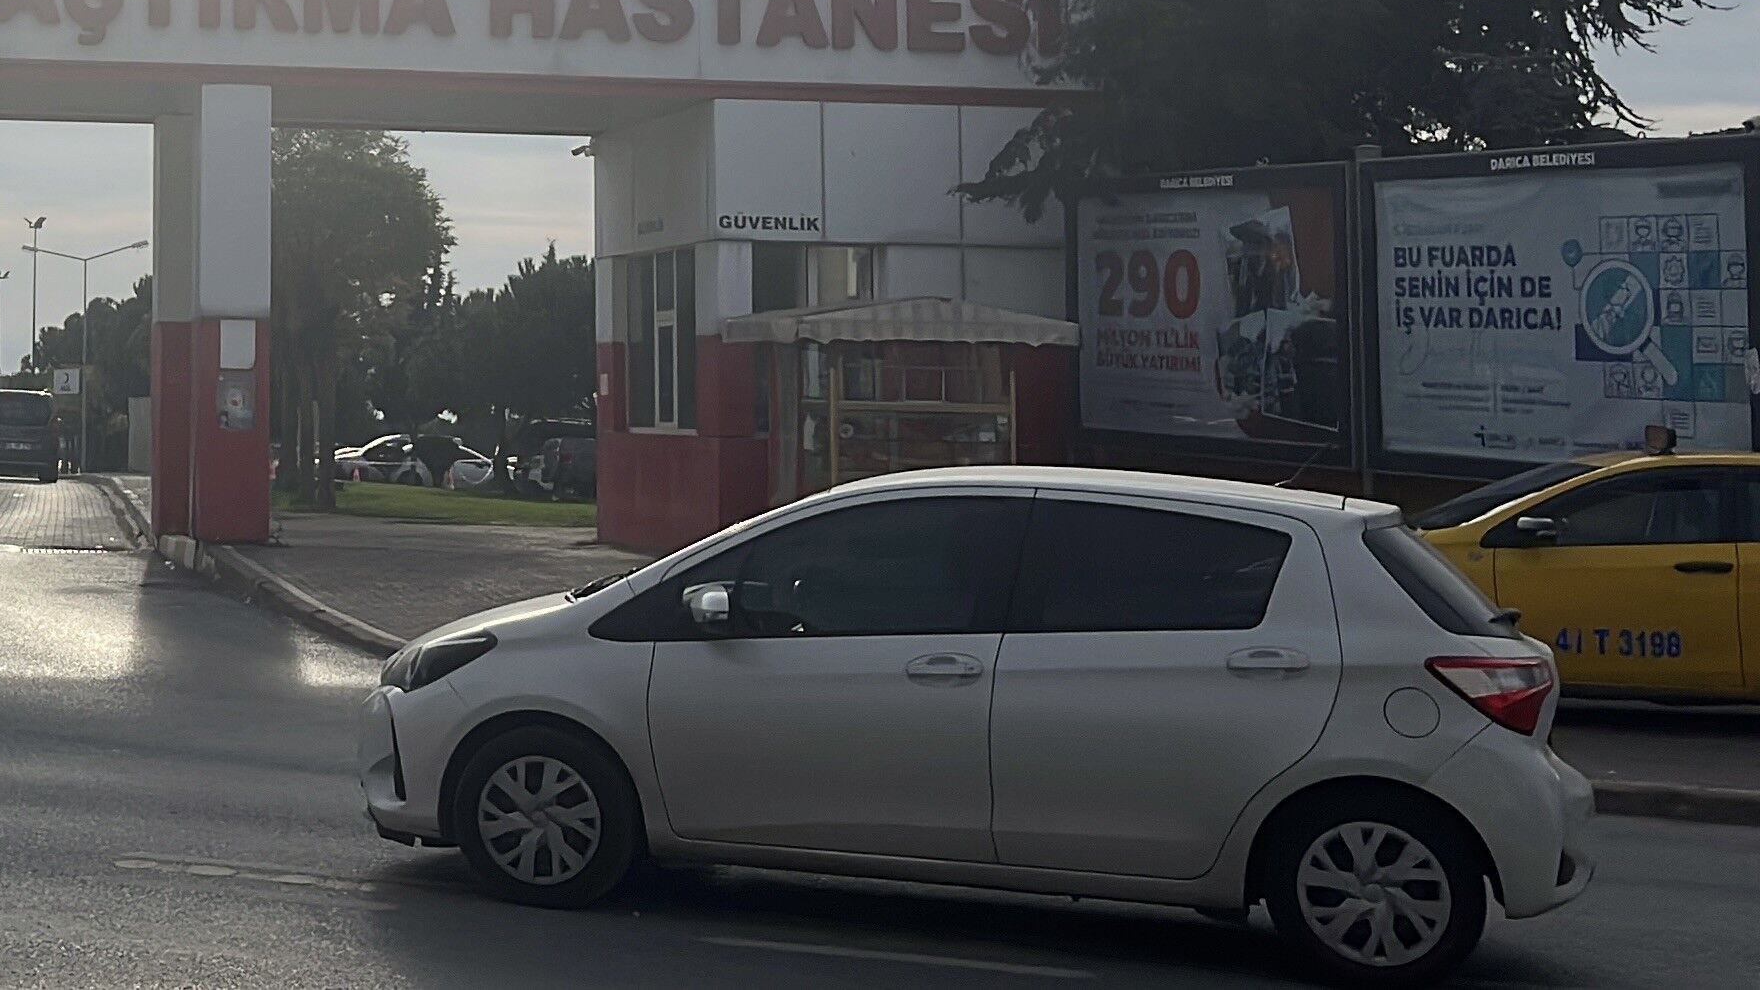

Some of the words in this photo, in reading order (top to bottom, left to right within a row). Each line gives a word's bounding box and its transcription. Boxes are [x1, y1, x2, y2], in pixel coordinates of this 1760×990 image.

[1490, 155, 1531, 170] DARICA
[718, 211, 820, 232] GÜVENLİK
[1393, 246, 1421, 268] BU
[1427, 245, 1517, 268] FUARDA
[1095, 249, 1201, 320] 290
[1394, 269, 1460, 298] SENİN
[1466, 269, 1513, 306] İÇİN
[1520, 276, 1552, 298] DE
[1395, 299, 1415, 335] İŞ
[1419, 307, 1464, 329] VAR
[1468, 307, 1562, 331] DARICA!
[1593, 628, 1610, 656] T
